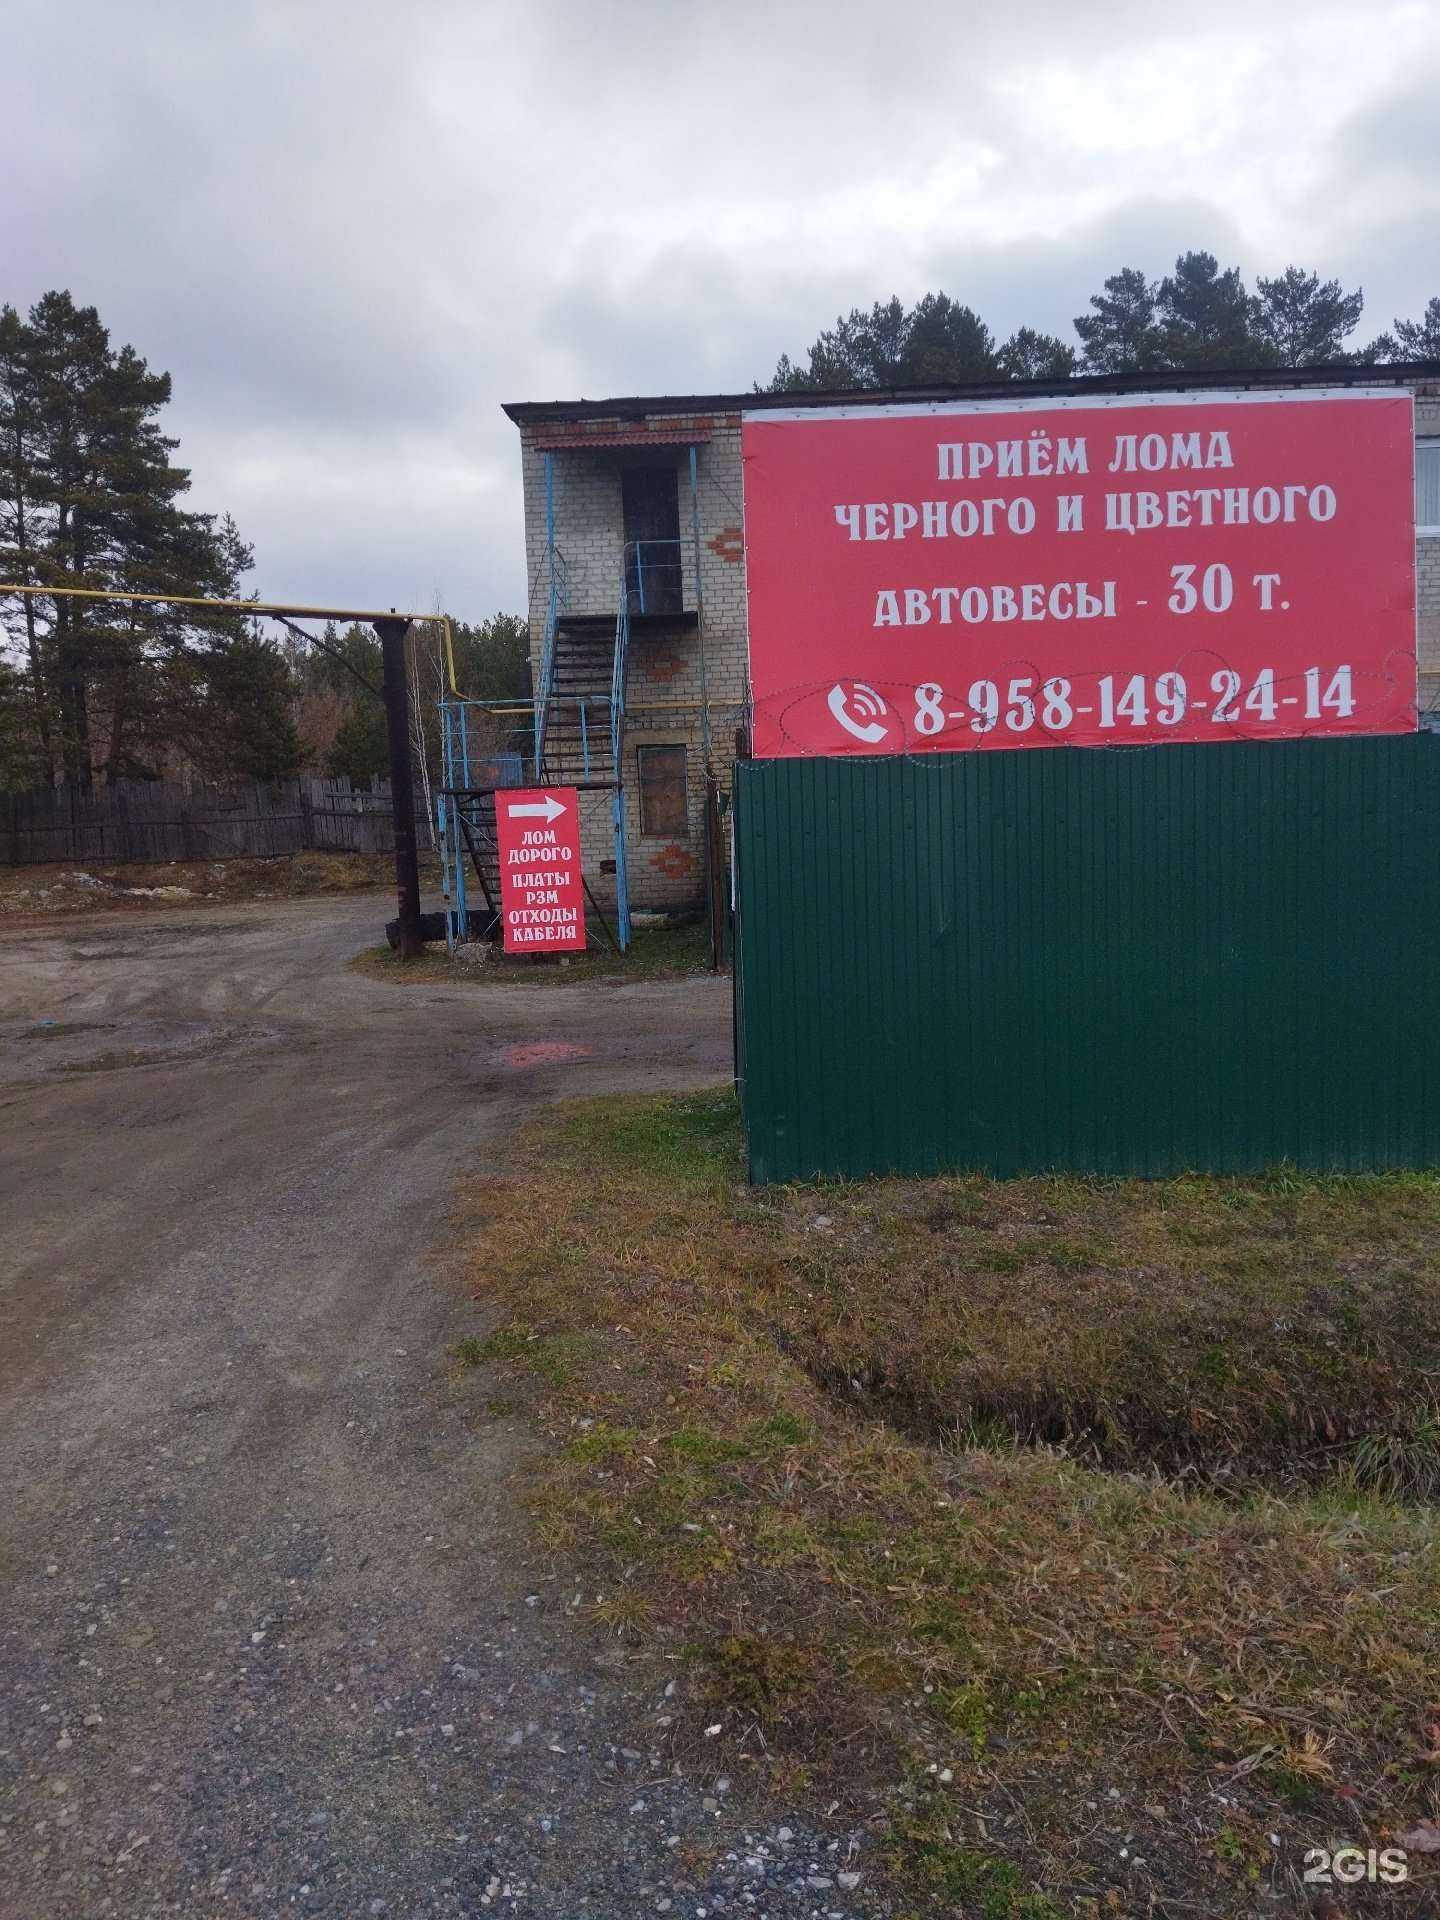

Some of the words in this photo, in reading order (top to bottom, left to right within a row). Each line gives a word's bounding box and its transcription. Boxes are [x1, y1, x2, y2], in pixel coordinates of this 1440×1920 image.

[937, 431, 1089, 480] ПРИЁМ
[1108, 431, 1234, 473] ЛОМА
[834, 497, 1036, 542] ЧЕРНОГО
[1056, 495, 1084, 532] И
[1104, 484, 1337, 535] ЦВЕТНОГО
[872, 581, 1117, 627] АВТОВЕСЫ
[1168, 563, 1234, 614] 30
[913, 664, 1356, 735] 8-958-149-24-14
[522, 830, 556, 845] ЛОМ
[508, 847, 572, 865] ДОРОГО
[512, 872, 571, 888] ПЛАТЫ
[508, 908, 578, 925] ОТХОДЫ
[513, 926, 577, 942] КАБЕЛЯ
